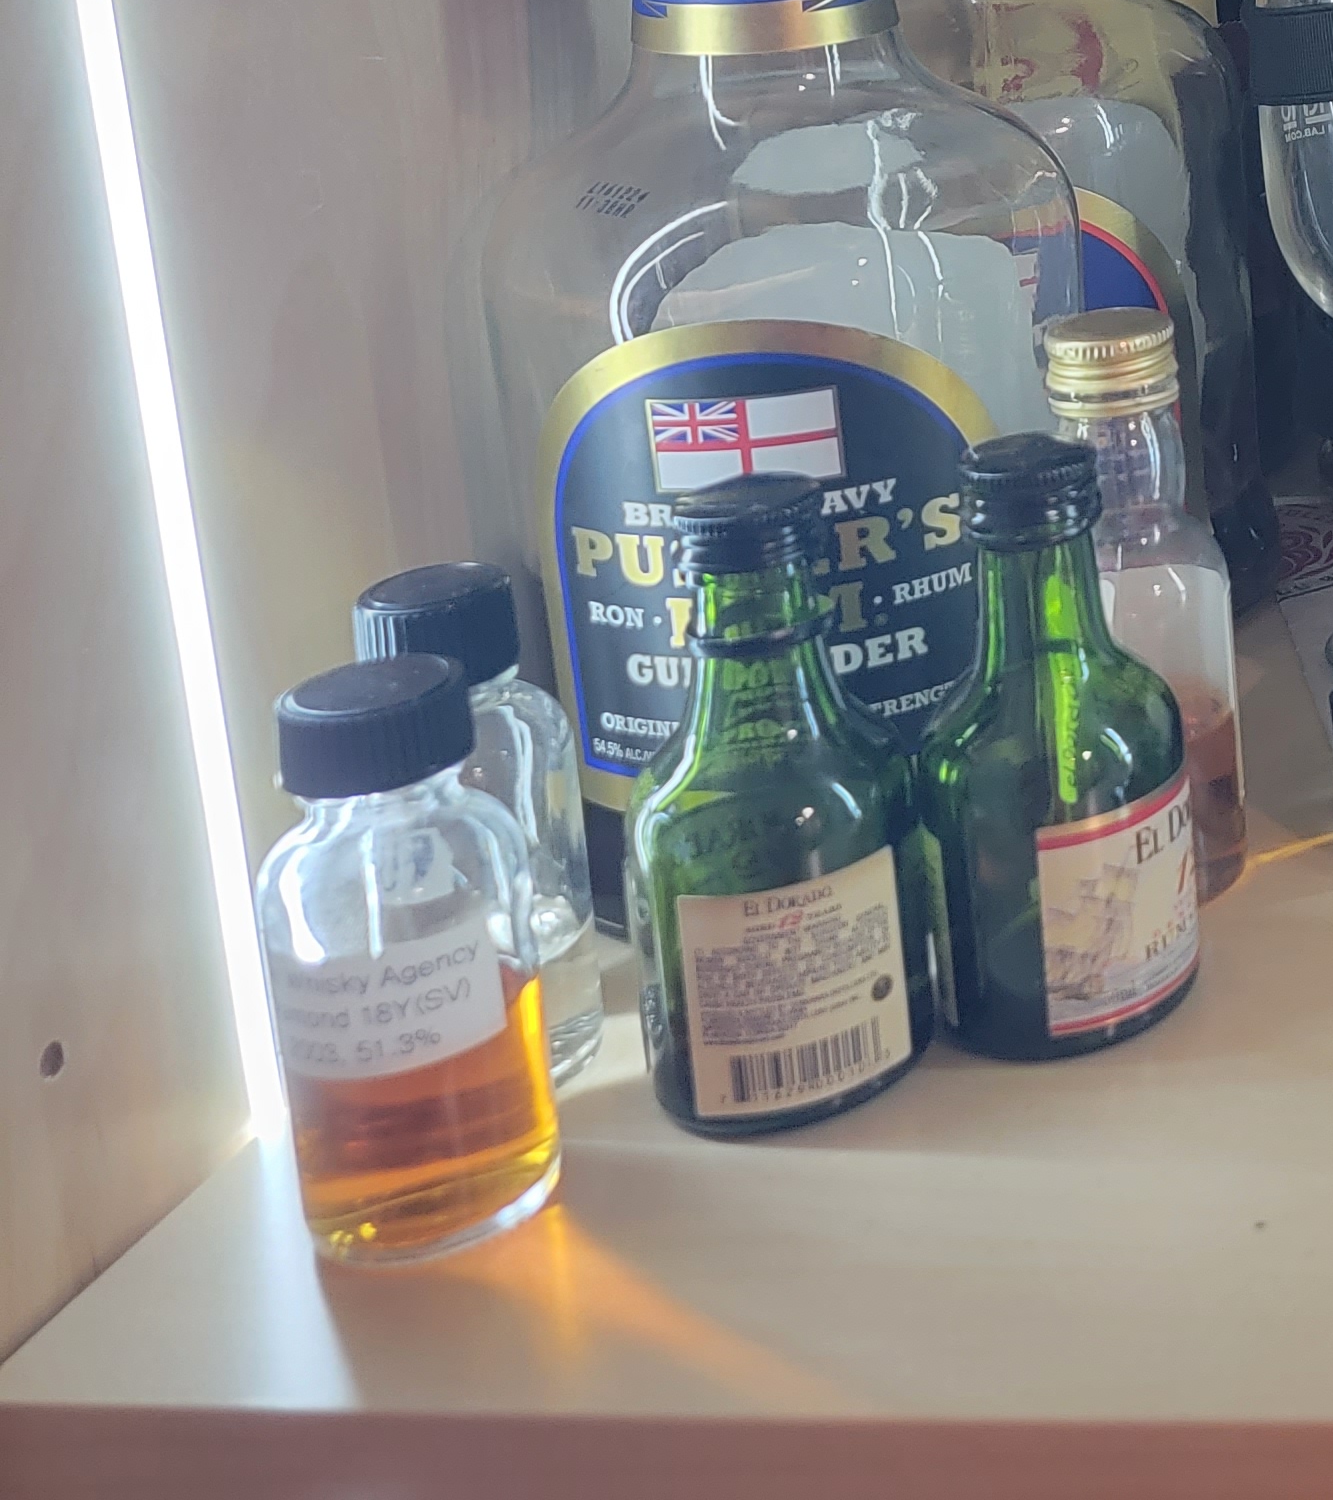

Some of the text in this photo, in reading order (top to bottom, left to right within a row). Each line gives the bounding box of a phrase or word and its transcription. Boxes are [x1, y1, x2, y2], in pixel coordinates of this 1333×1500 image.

[588, 600, 644, 629] RON
[893, 562, 972, 605] RHUM
[592, 737, 625, 759] 54.5%
[379, 939, 480, 989] Agency
[356, 1027, 442, 1062] 51.3%
